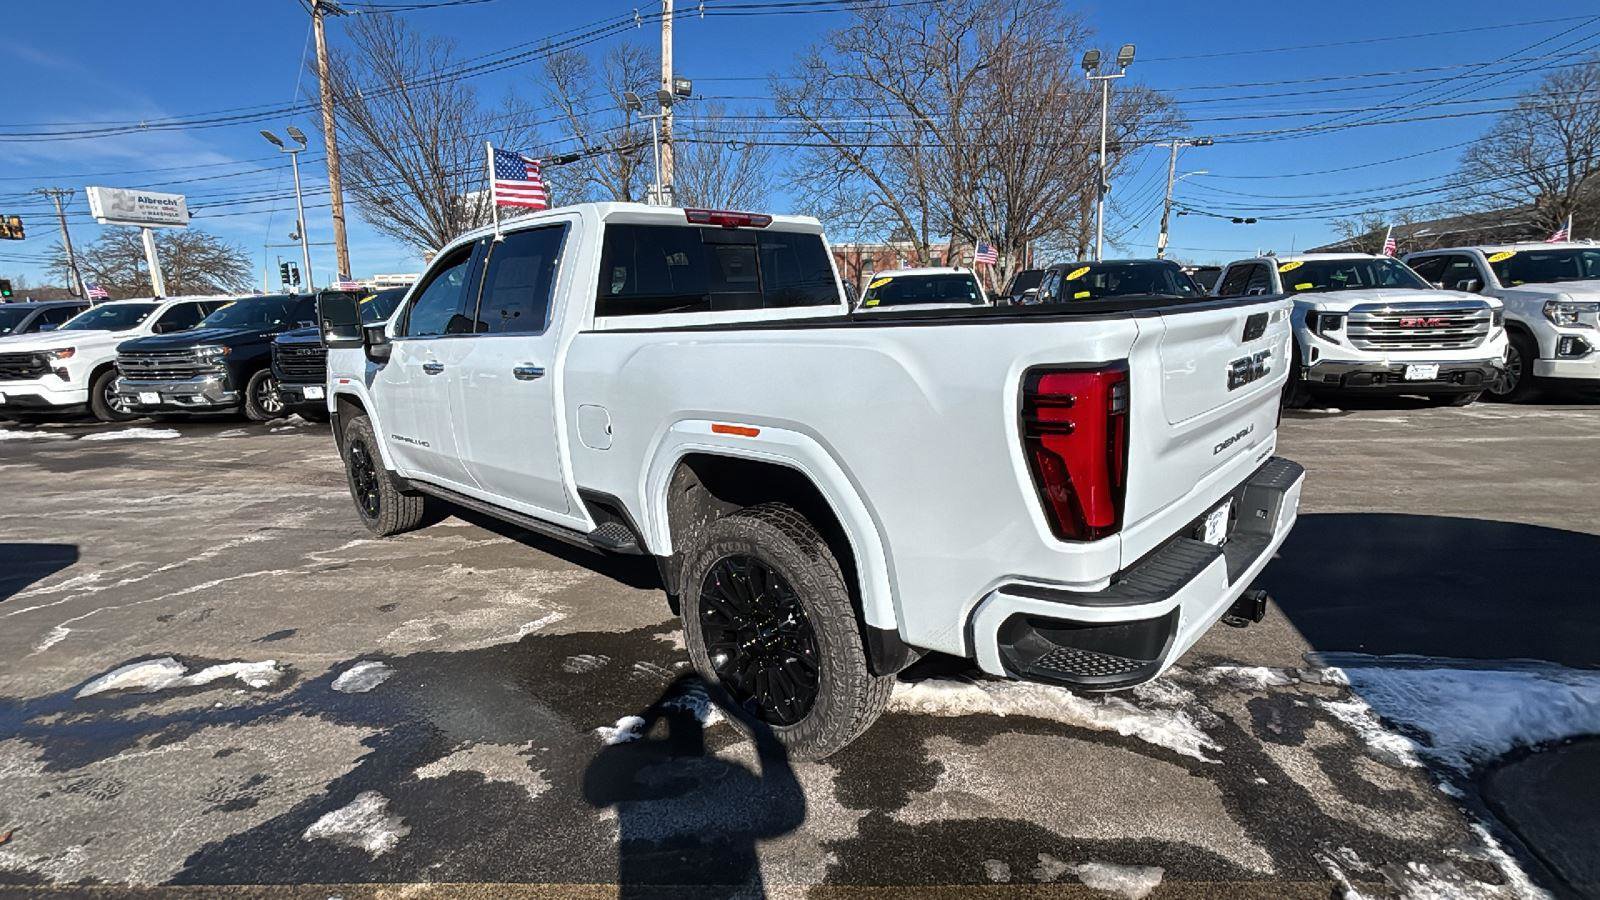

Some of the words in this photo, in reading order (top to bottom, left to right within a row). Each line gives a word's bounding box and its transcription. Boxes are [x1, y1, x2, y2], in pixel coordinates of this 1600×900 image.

[138, 196, 177, 206] Albrecht
[1399, 317, 1451, 328] GMC
[1227, 349, 1271, 392] GMC
[1213, 423, 1254, 455] DENALI
